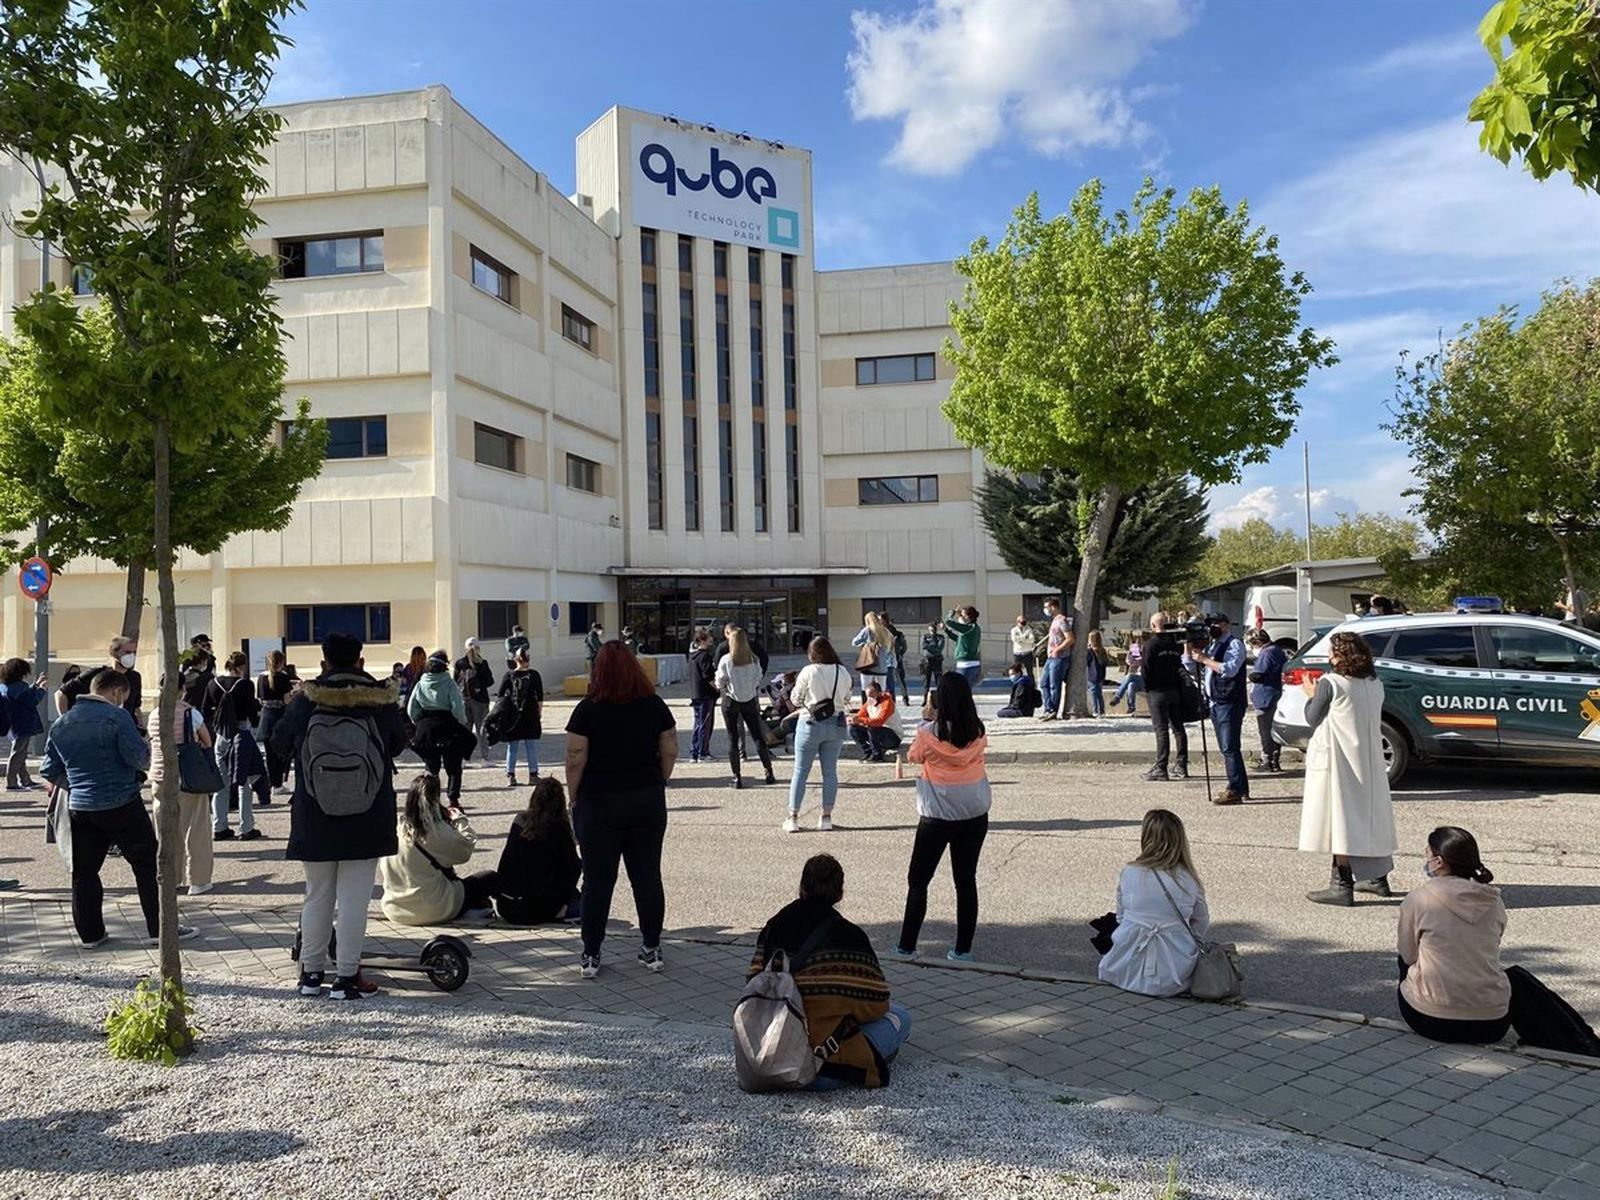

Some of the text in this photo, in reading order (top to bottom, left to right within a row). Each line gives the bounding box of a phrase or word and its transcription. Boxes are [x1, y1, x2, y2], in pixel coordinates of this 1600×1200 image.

[639, 143, 777, 205] qube
[688, 210, 761, 231] TECHNOLOGY
[733, 230, 761, 241] PARK
[1421, 695, 1568, 713] GUARDIA CIVIL
